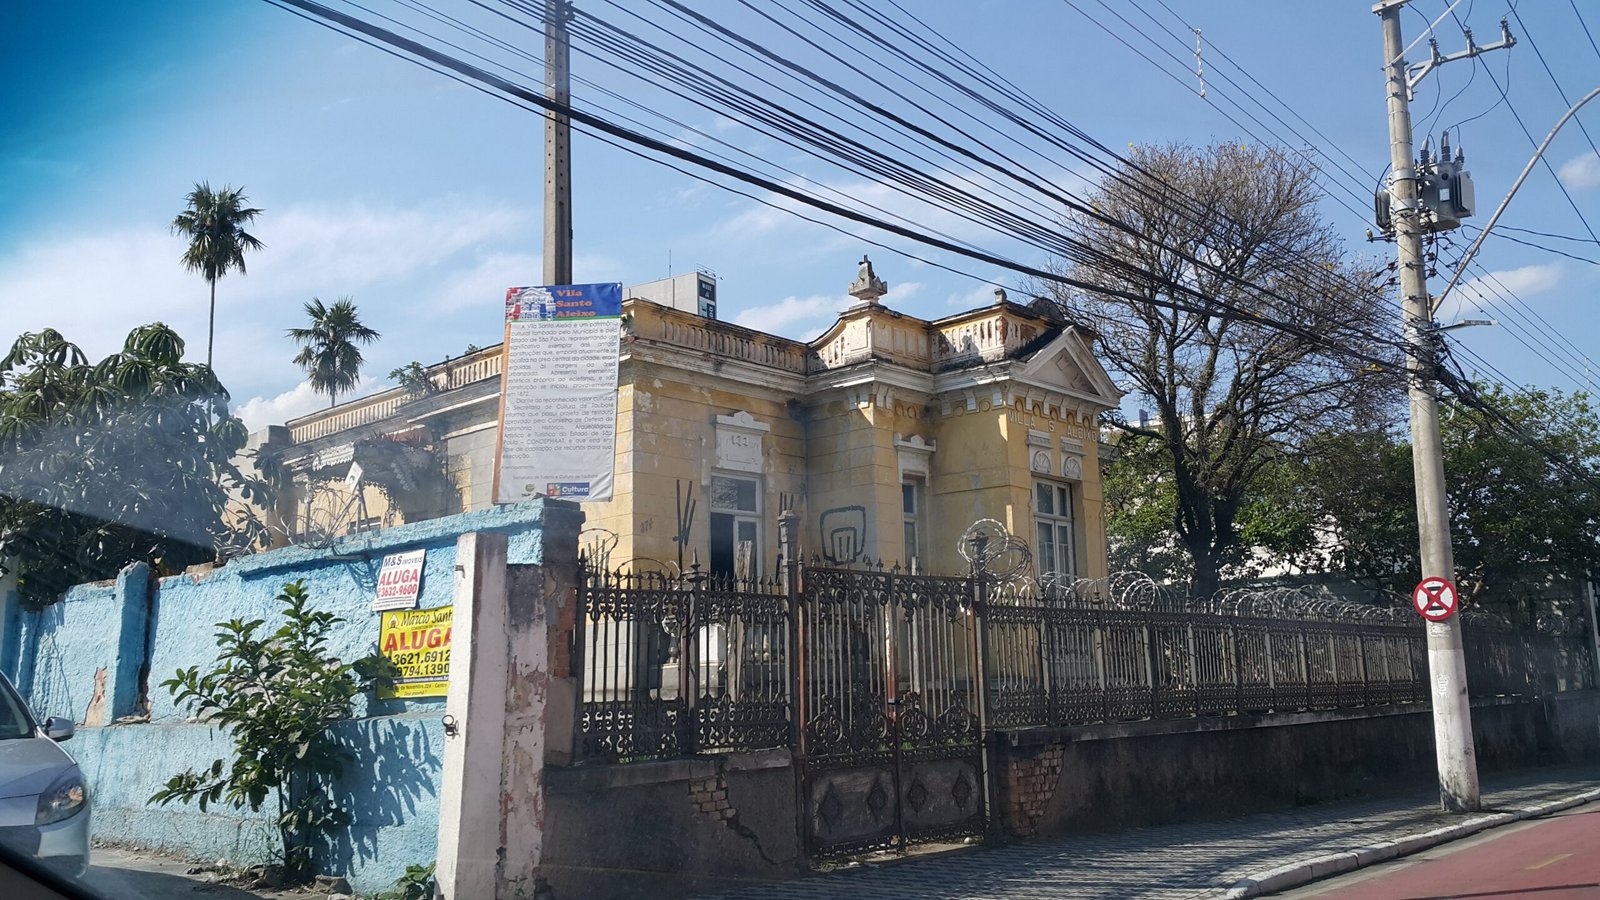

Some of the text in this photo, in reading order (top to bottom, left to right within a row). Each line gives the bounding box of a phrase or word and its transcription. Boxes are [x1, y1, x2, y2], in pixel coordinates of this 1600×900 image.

[556, 289, 583, 297] Vila
[556, 300, 593, 308] Santo
[555, 310, 597, 318] Aleixo
[379, 569, 418, 586] ALUGA
[381, 584, 418, 598] 3632-9600
[400, 609, 453, 627] Márcio Sant
[383, 627, 452, 651] ALUGA
